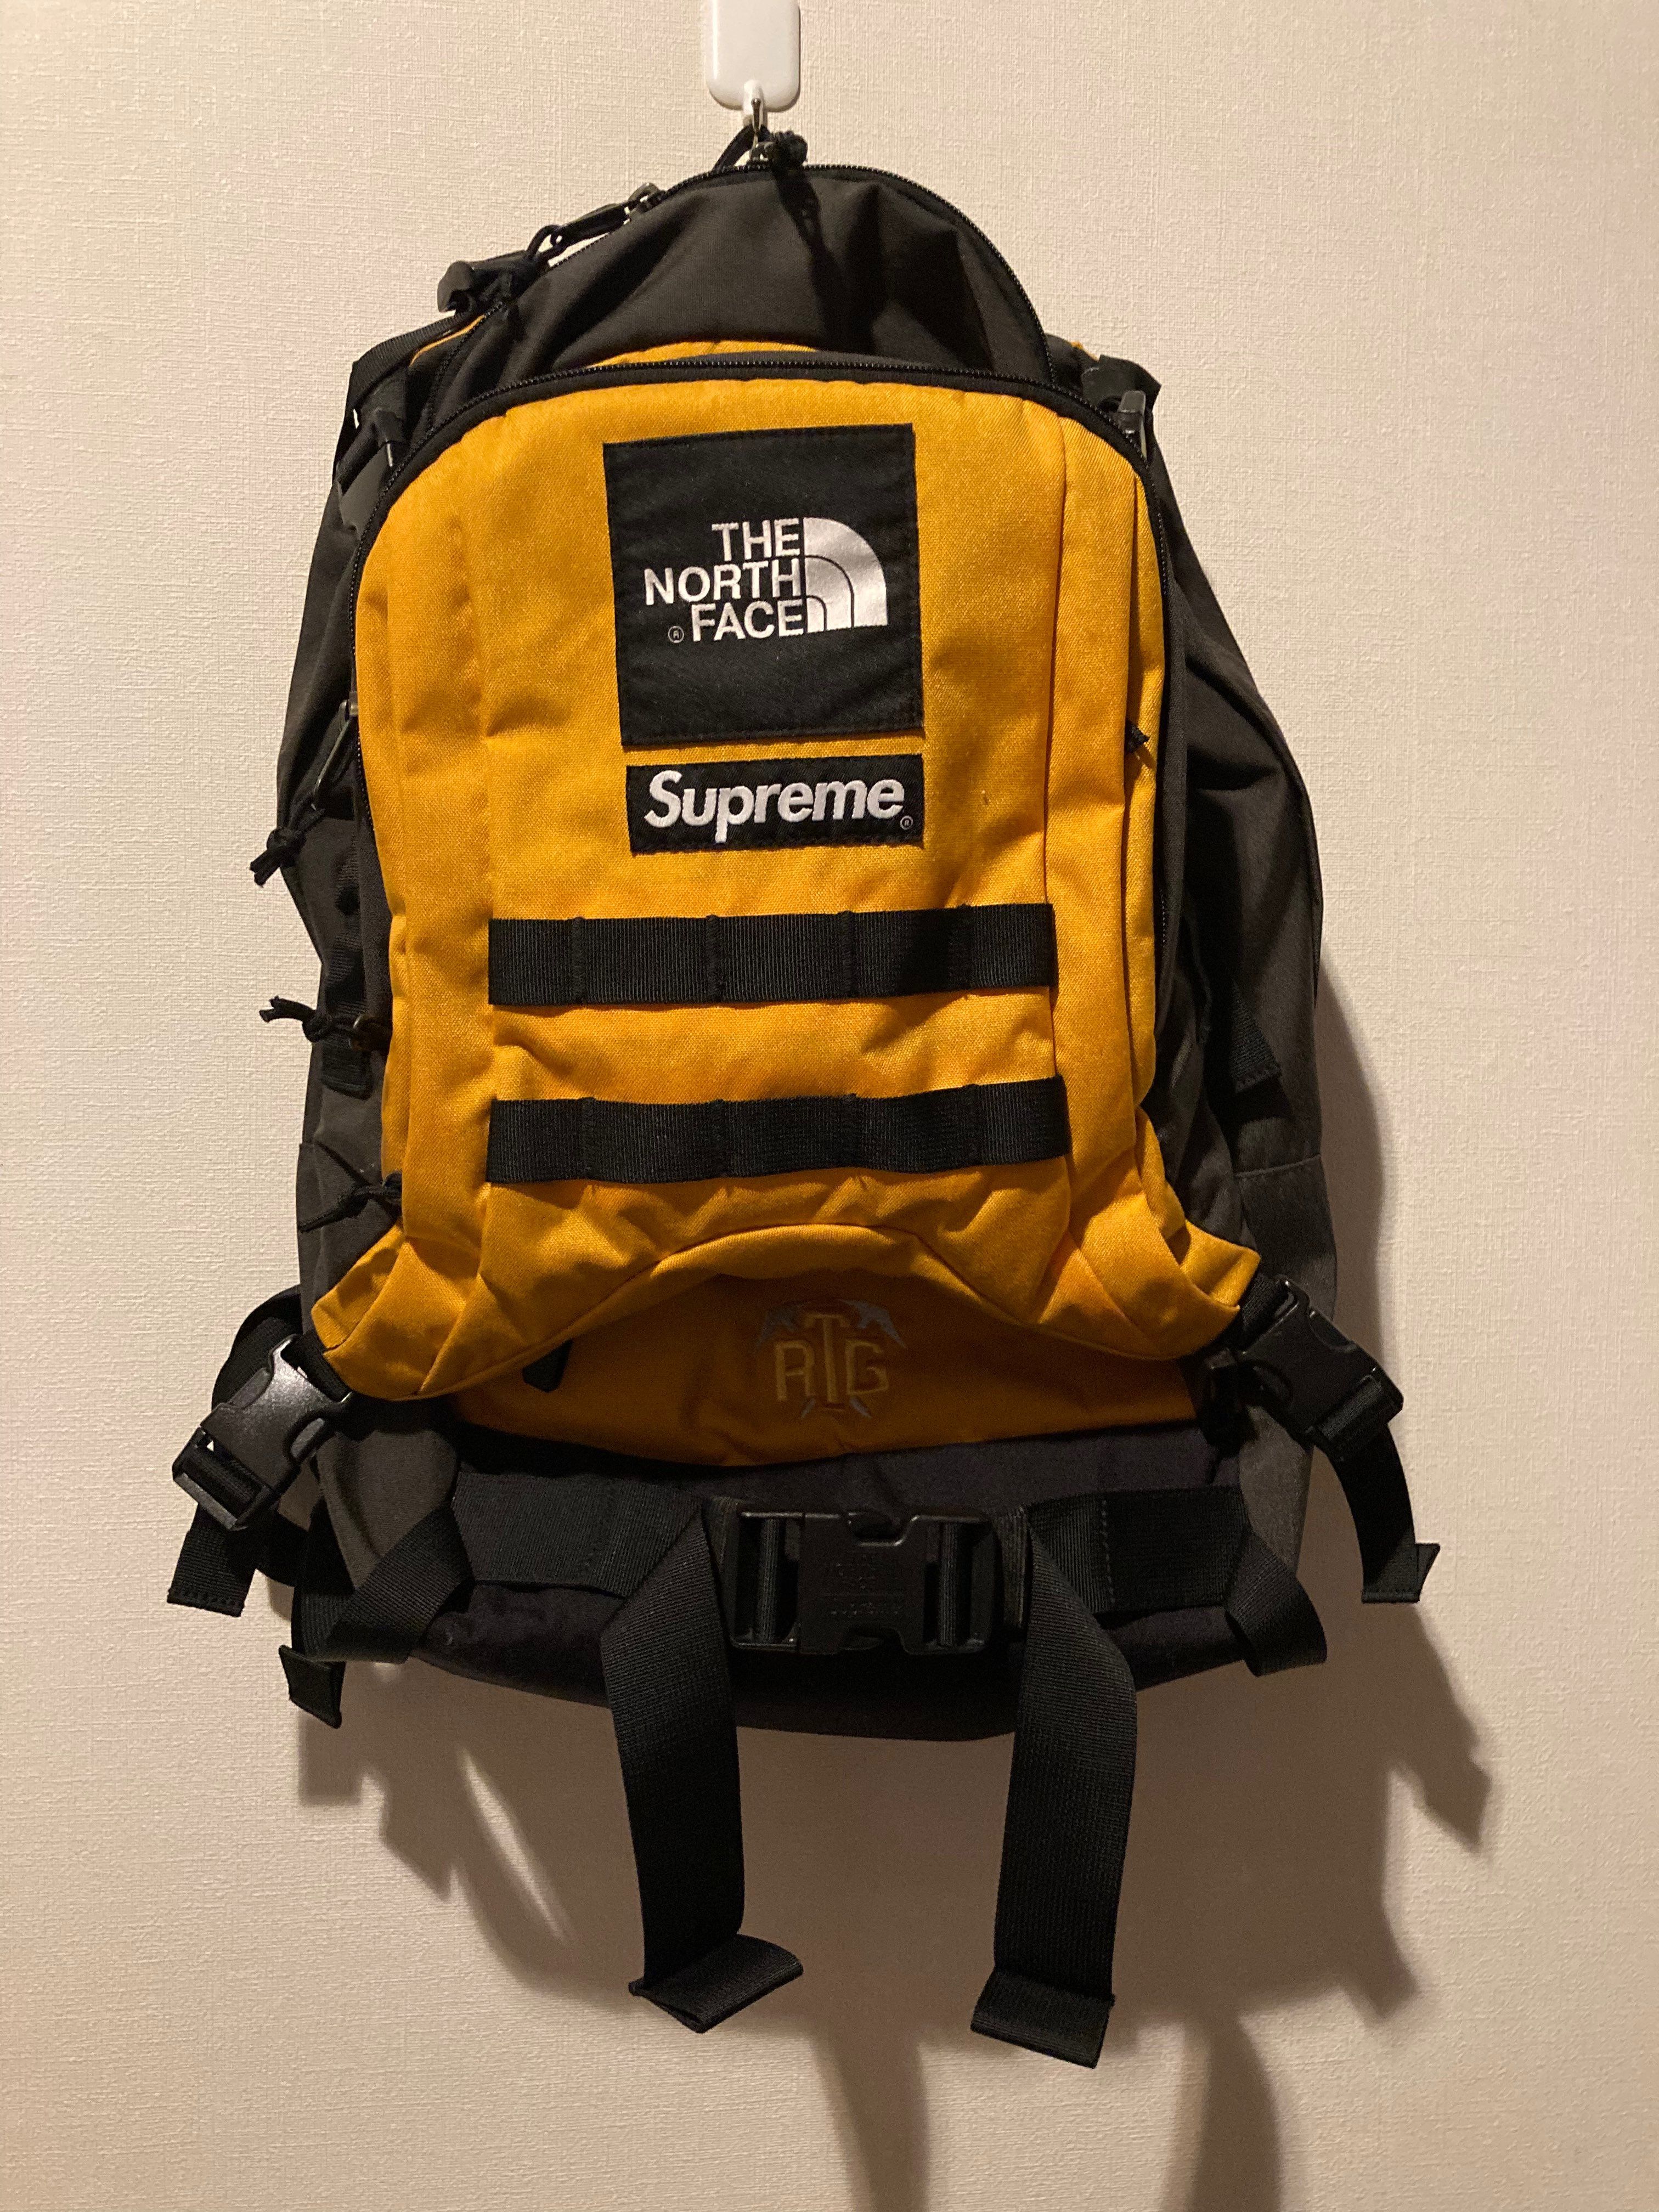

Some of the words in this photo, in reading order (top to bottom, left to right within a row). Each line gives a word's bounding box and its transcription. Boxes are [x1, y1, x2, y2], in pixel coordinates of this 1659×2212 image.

[712, 517, 800, 561] THE
[644, 560, 802, 605] NORTH
[691, 599, 804, 642] FACE
[644, 770, 905, 843] Supreme
